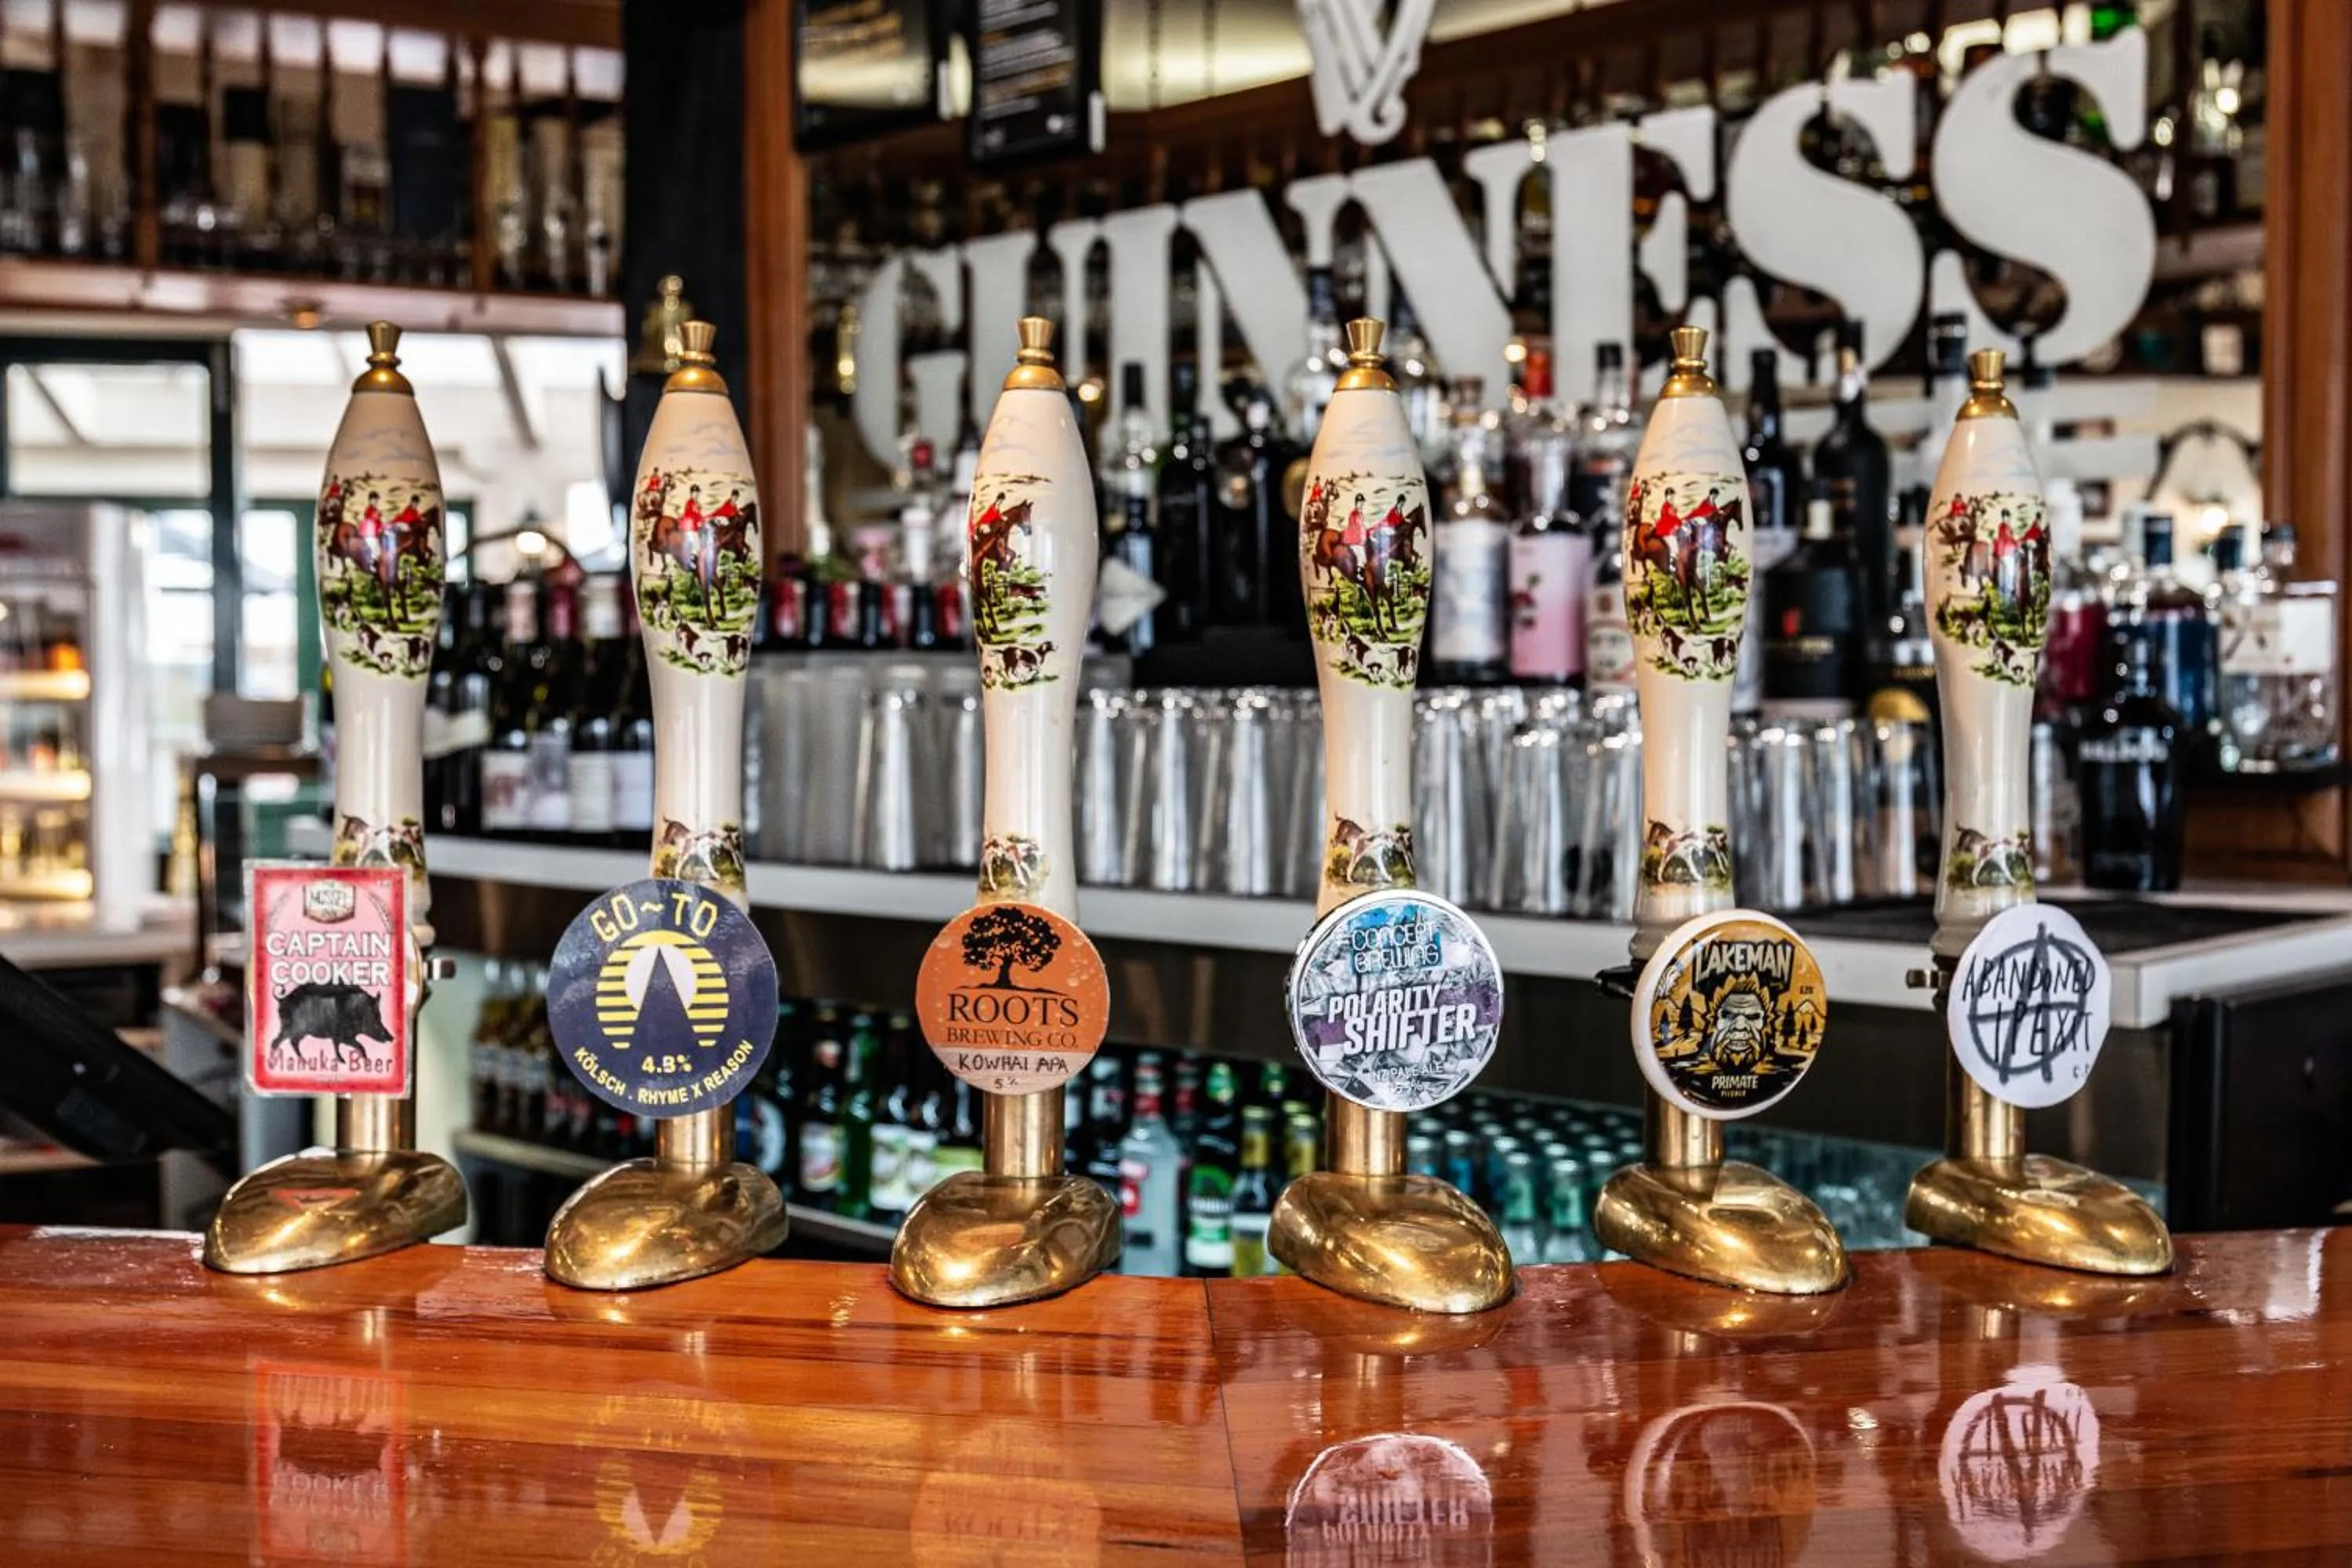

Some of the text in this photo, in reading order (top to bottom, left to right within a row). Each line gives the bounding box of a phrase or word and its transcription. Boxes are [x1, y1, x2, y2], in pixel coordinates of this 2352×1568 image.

[853, 26, 2156, 472] GUINNESS
[266, 931, 390, 957] CAPTAIN
[270, 961, 390, 985] COOKER
[1695, 942, 1792, 984] LAKEMAN
[948, 993, 1079, 1027] ROOTS
[1327, 983, 1442, 1024] POLARITY
[947, 1027, 1079, 1050] BREWING CO.
[1343, 1002, 1478, 1055] SHIFTER
[349, 1049, 394, 1073] Beer
[574, 1047, 627, 1096] KÖLSCH
[637, 1087, 689, 1105] RHYME
[702, 1039, 754, 1091] REASON
[958, 1053, 1069, 1074] KOWHAI APA
[1711, 1074, 1759, 1091] PRIMATE
